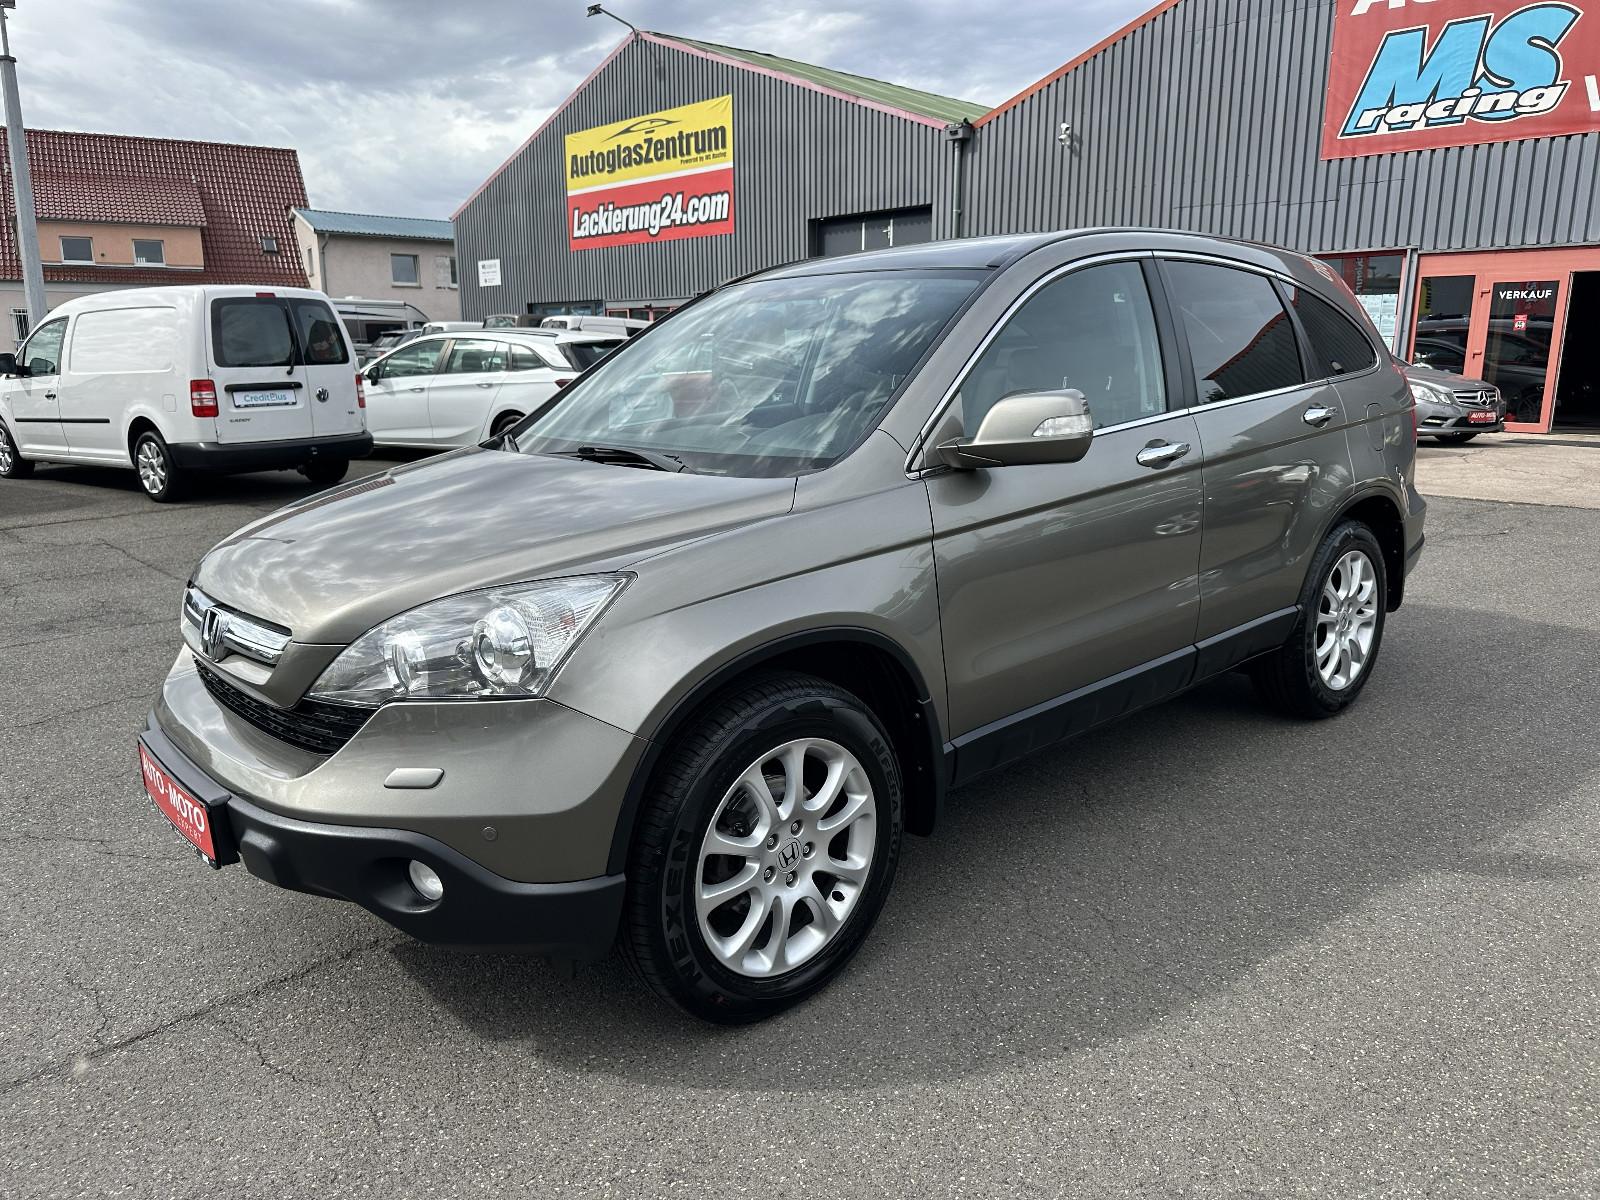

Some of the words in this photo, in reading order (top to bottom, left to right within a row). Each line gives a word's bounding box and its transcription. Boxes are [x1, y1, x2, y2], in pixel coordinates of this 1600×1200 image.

[1338, 1, 1584, 138] MS
[1354, 82, 1570, 130] racing
[571, 125, 727, 178] AutoglasZentrum
[572, 191, 730, 237] Lackierung24.com
[1499, 290, 1553, 299] VERKAUF
[243, 393, 288, 403] CreditPlus
[142, 752, 205, 832] AUTO-MOTO
[664, 830, 703, 978] NEXEN
